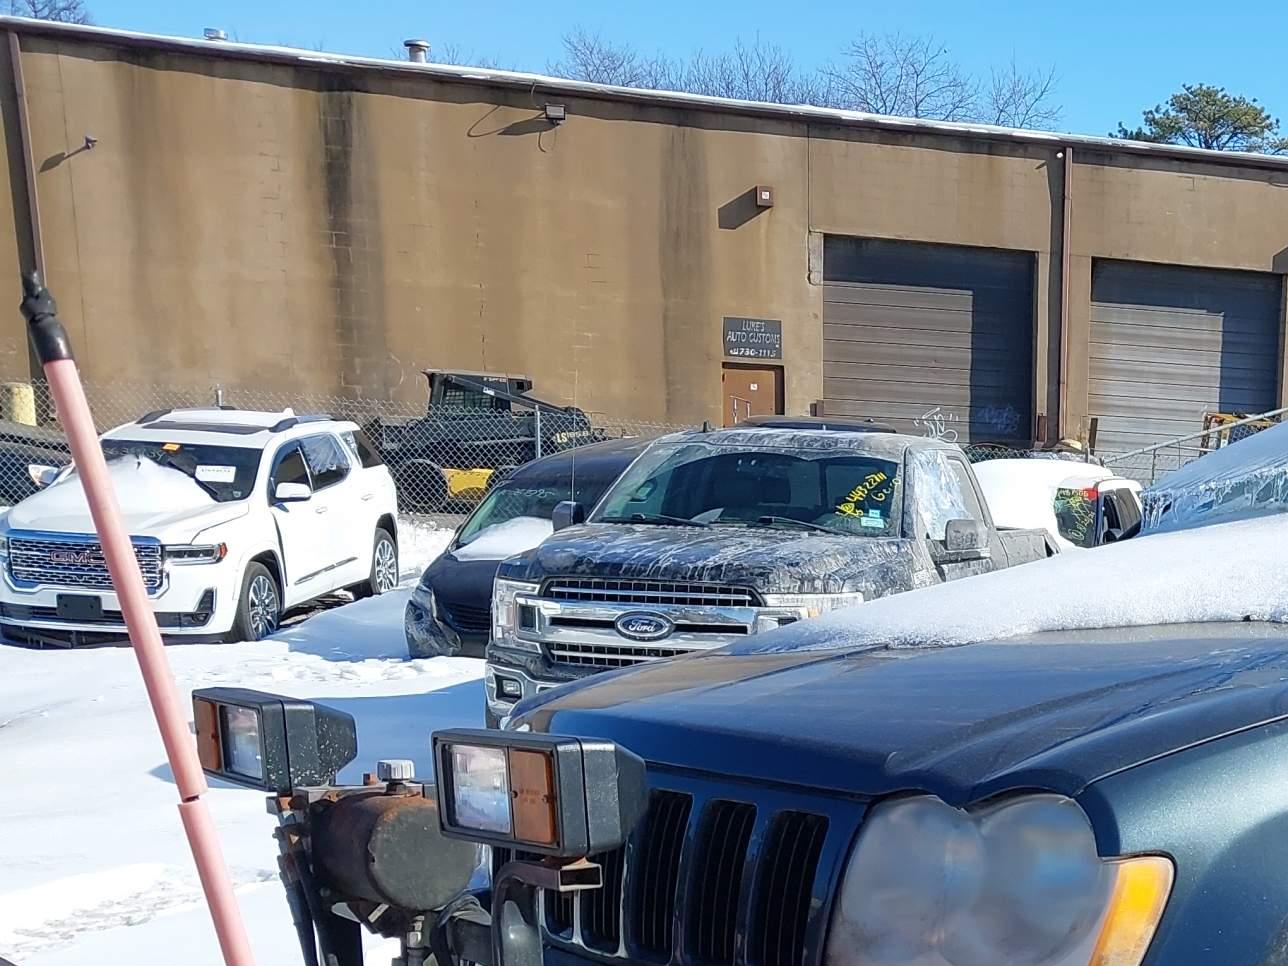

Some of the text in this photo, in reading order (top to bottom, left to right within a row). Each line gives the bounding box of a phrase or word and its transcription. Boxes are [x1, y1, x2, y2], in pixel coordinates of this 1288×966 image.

[726, 330, 780, 344] AUTO CUSTOMS
[50, 550, 106, 563] GMC
[628, 618, 658, 633] Ford
